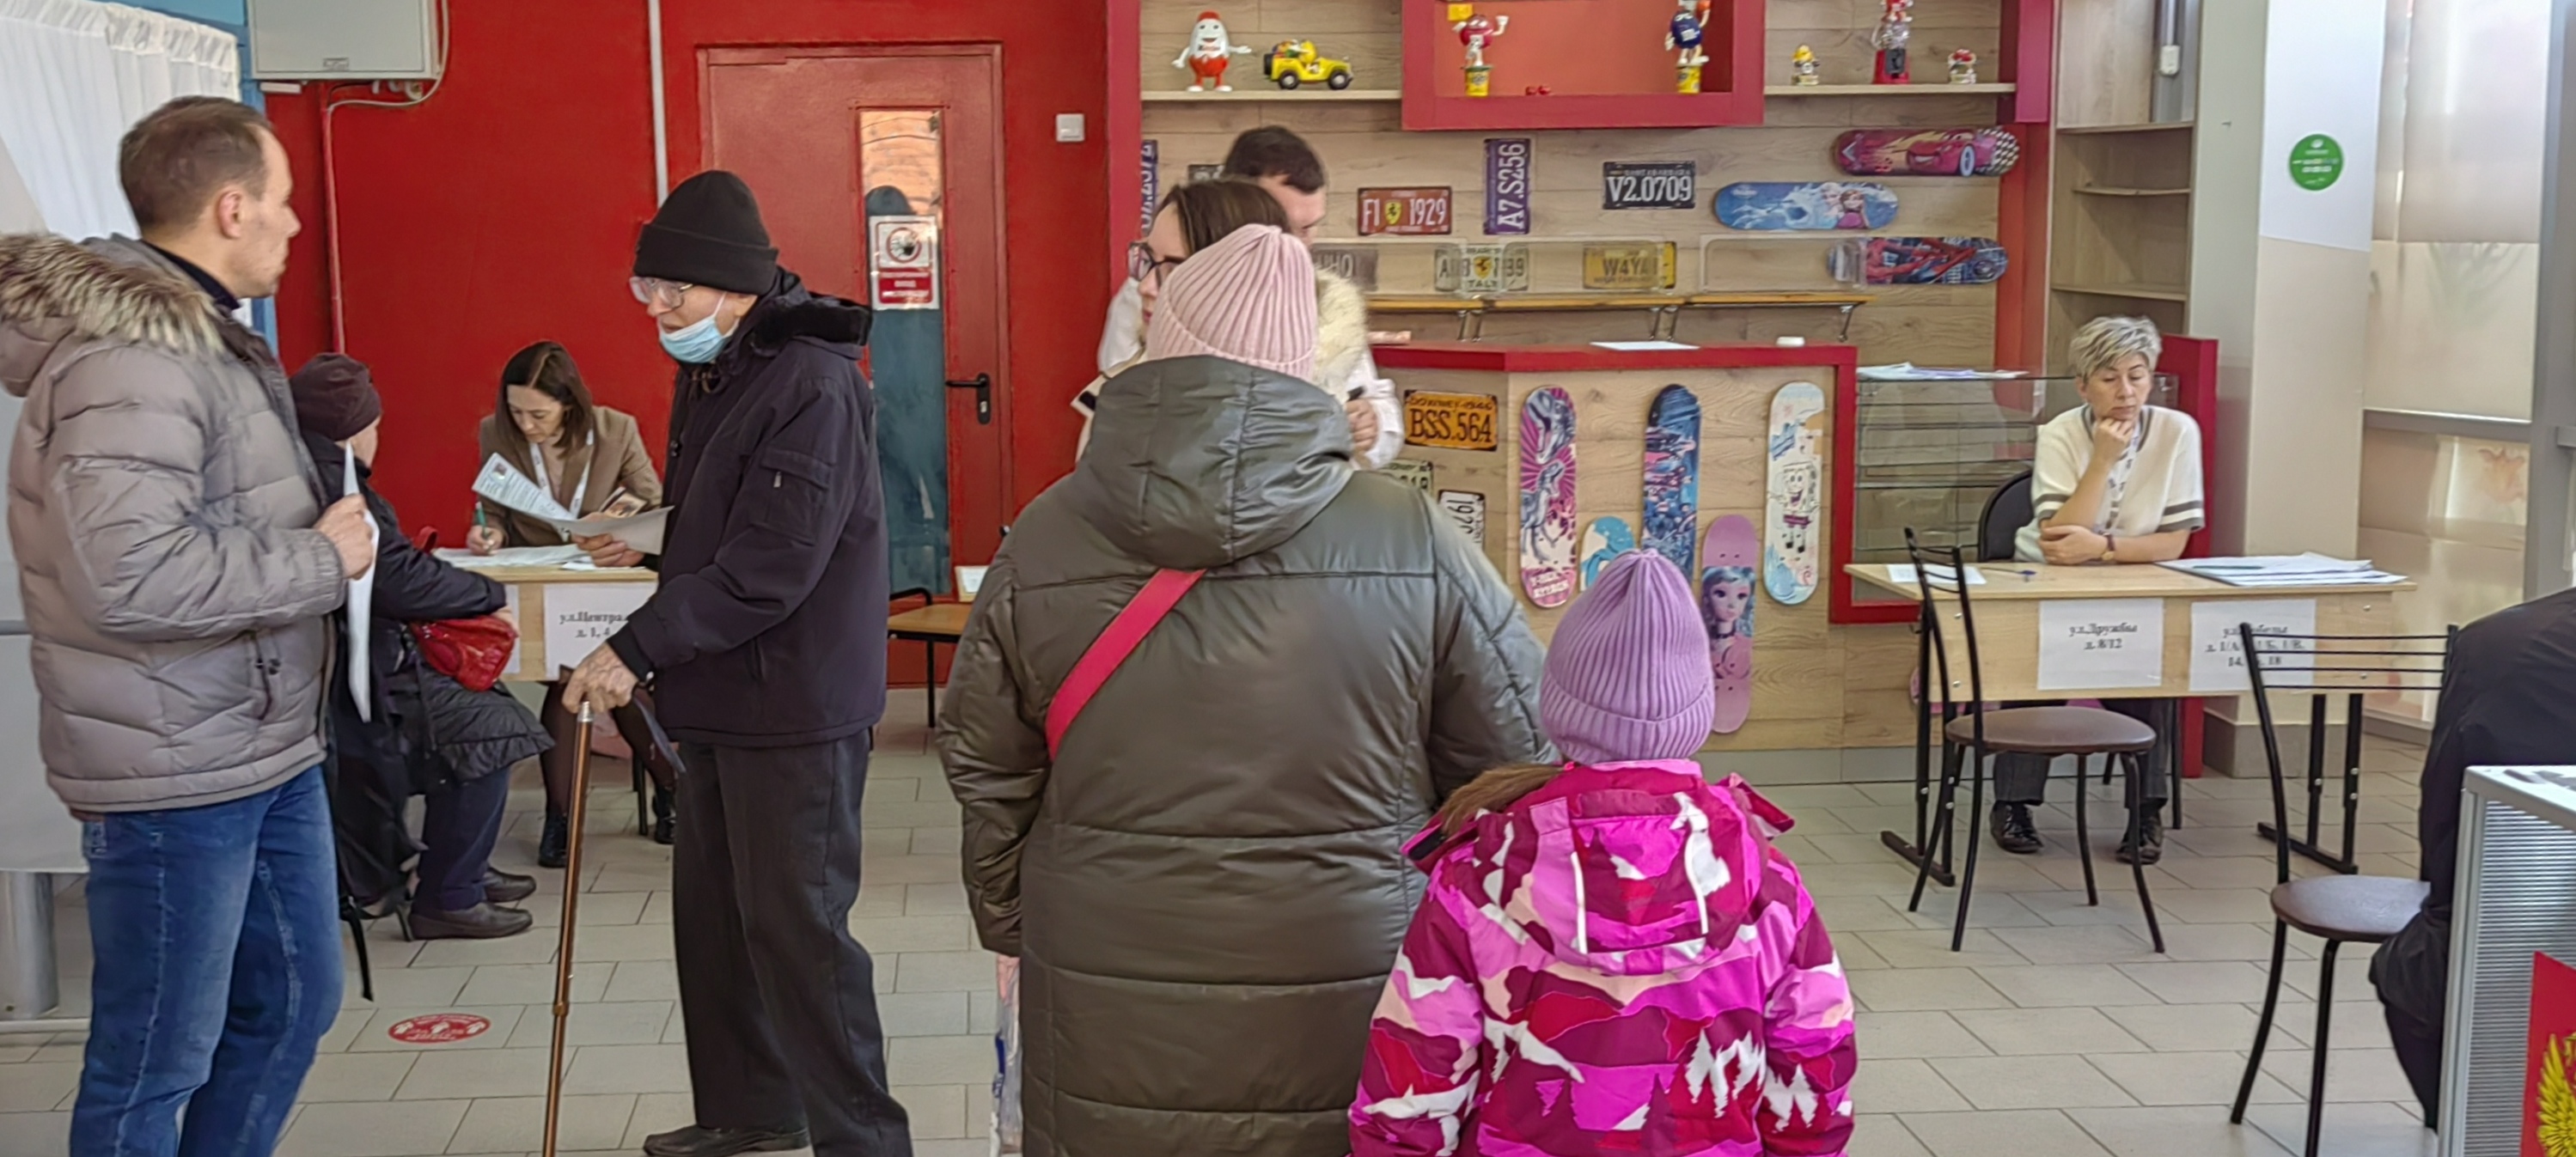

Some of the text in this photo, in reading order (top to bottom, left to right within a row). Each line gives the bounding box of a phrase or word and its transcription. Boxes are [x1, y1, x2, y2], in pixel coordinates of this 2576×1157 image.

[1497, 143, 1526, 229] A7.S256
[1606, 175, 1693, 202] V2.0709
[1362, 198, 1447, 227] F1 1929
[1409, 408, 1492, 443] BSS.564
